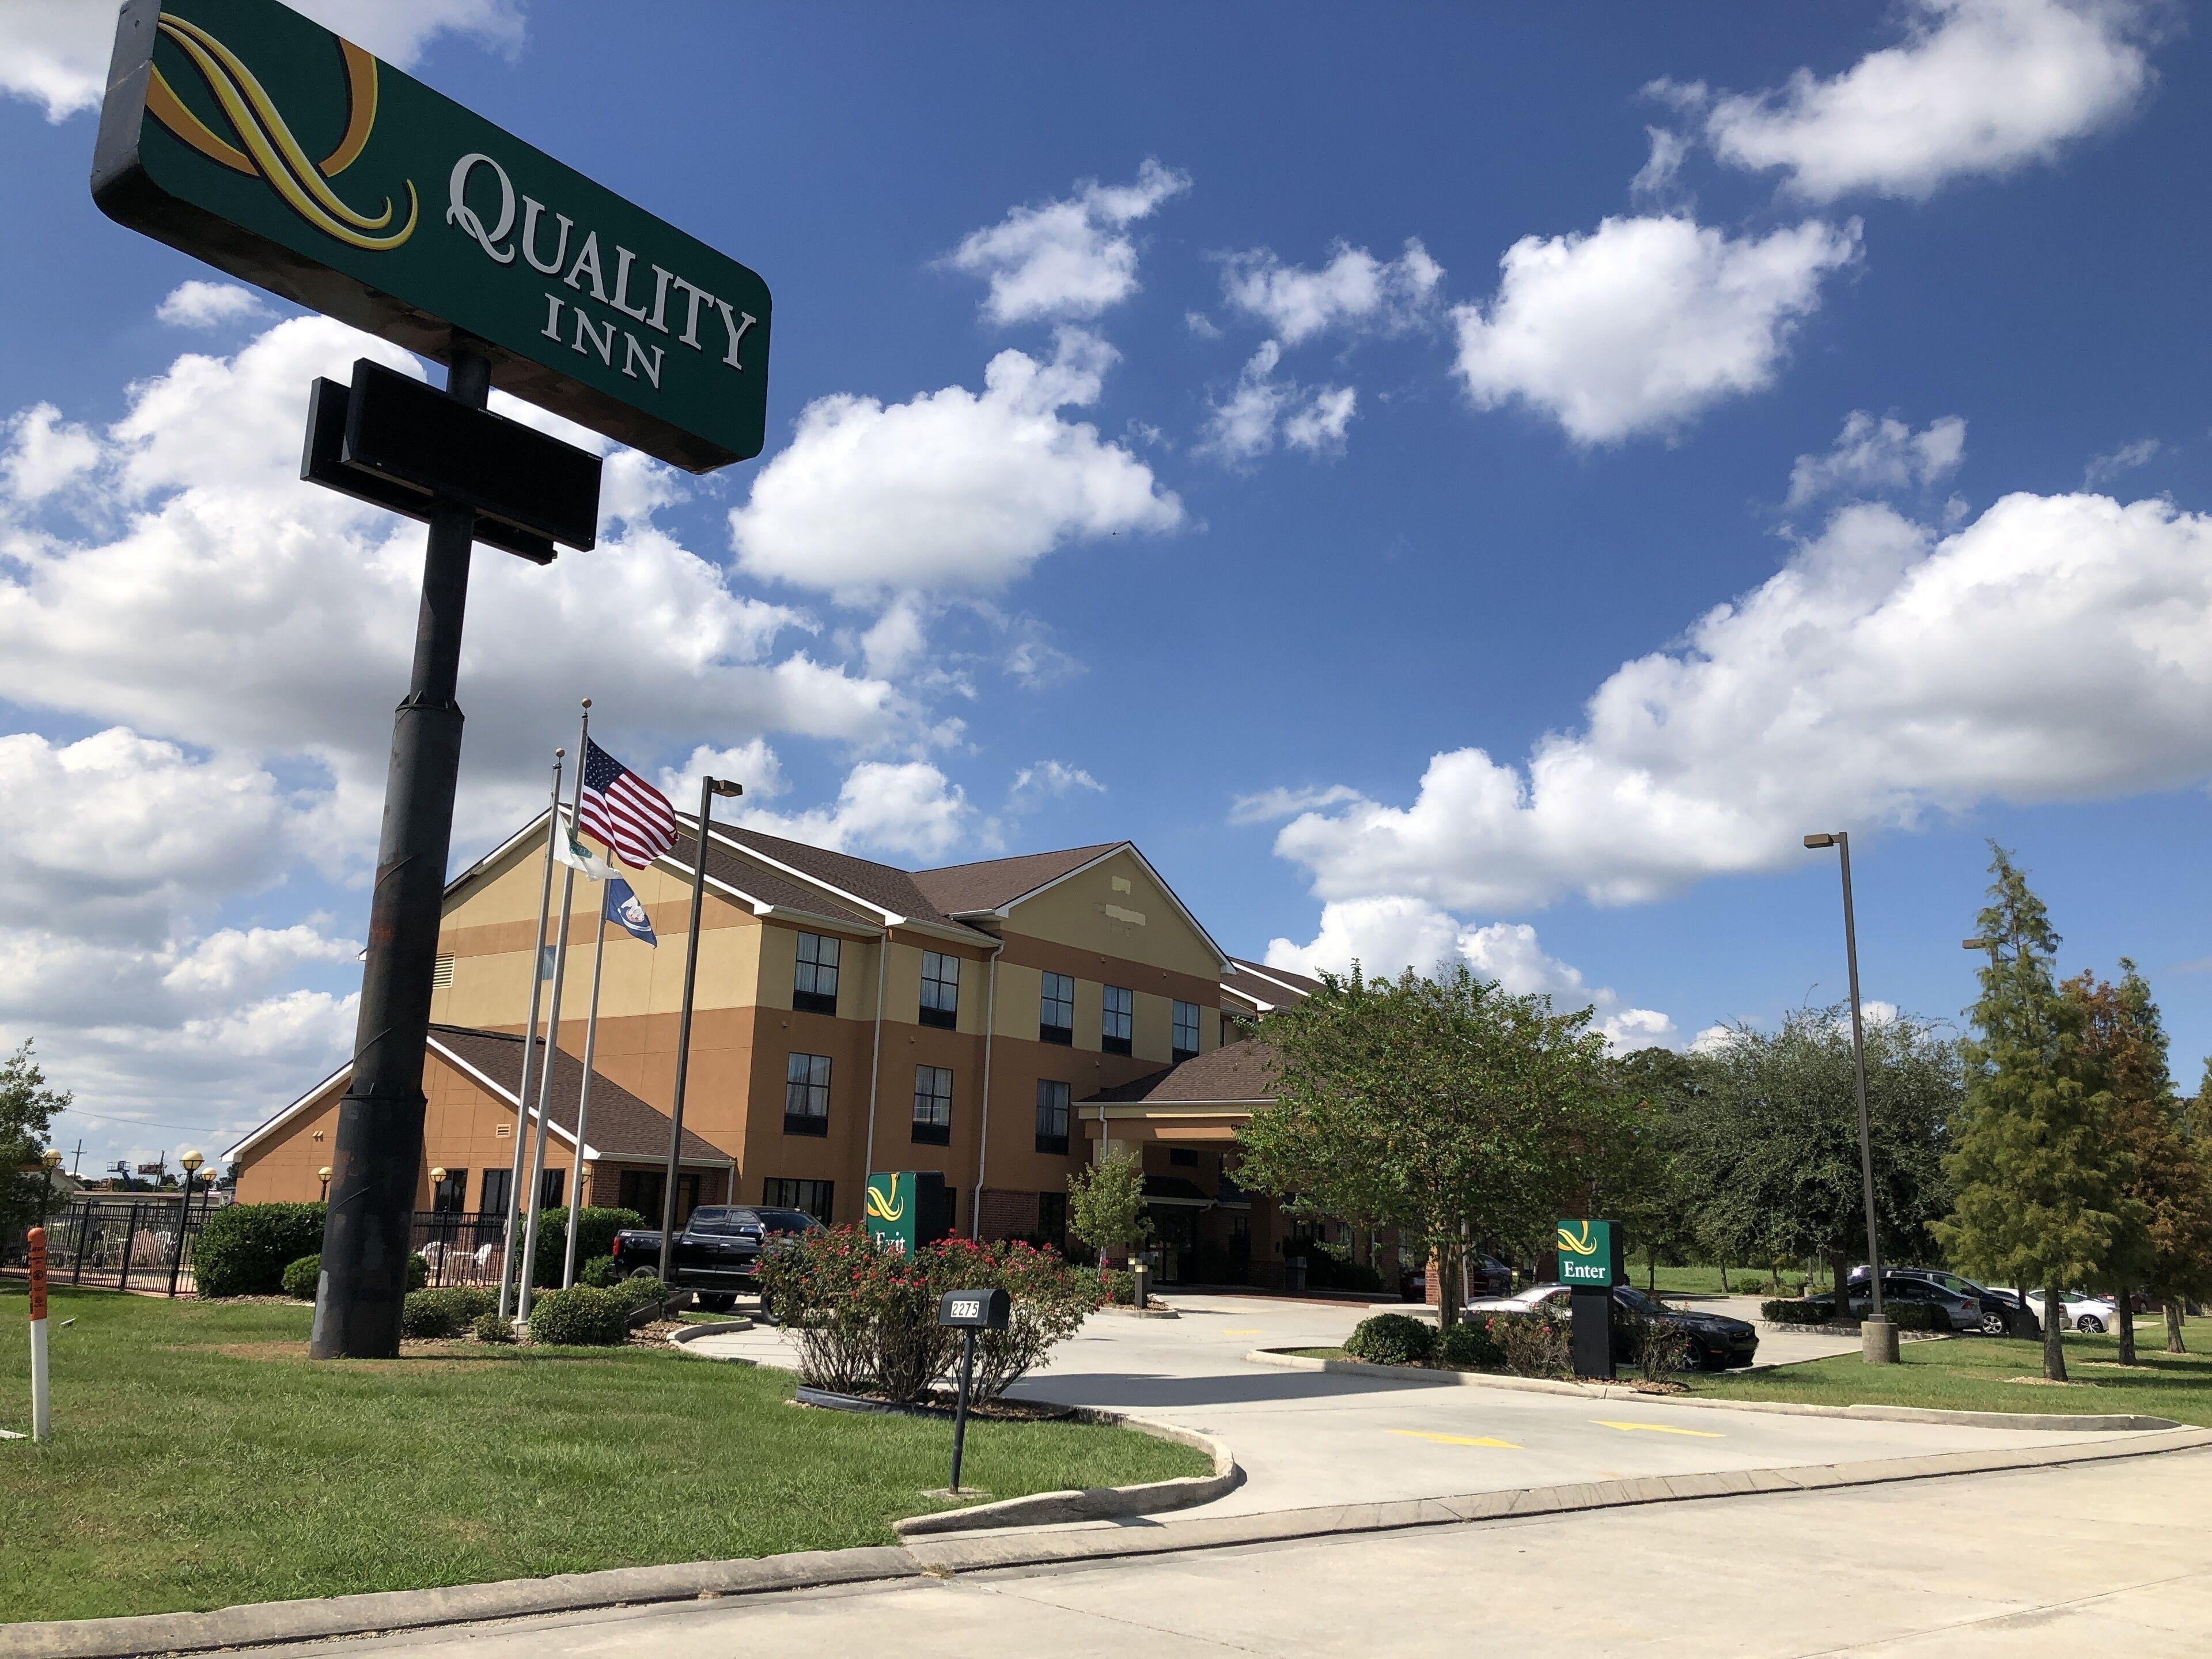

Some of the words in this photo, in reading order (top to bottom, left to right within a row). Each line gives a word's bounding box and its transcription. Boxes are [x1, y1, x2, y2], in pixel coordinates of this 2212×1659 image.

[446, 153, 756, 370] QUALITY
[541, 293, 664, 389] INN
[876, 1231, 906, 1253] Exit
[1563, 1261, 1606, 1278] Enter
[952, 1303, 978, 1316] 2275
